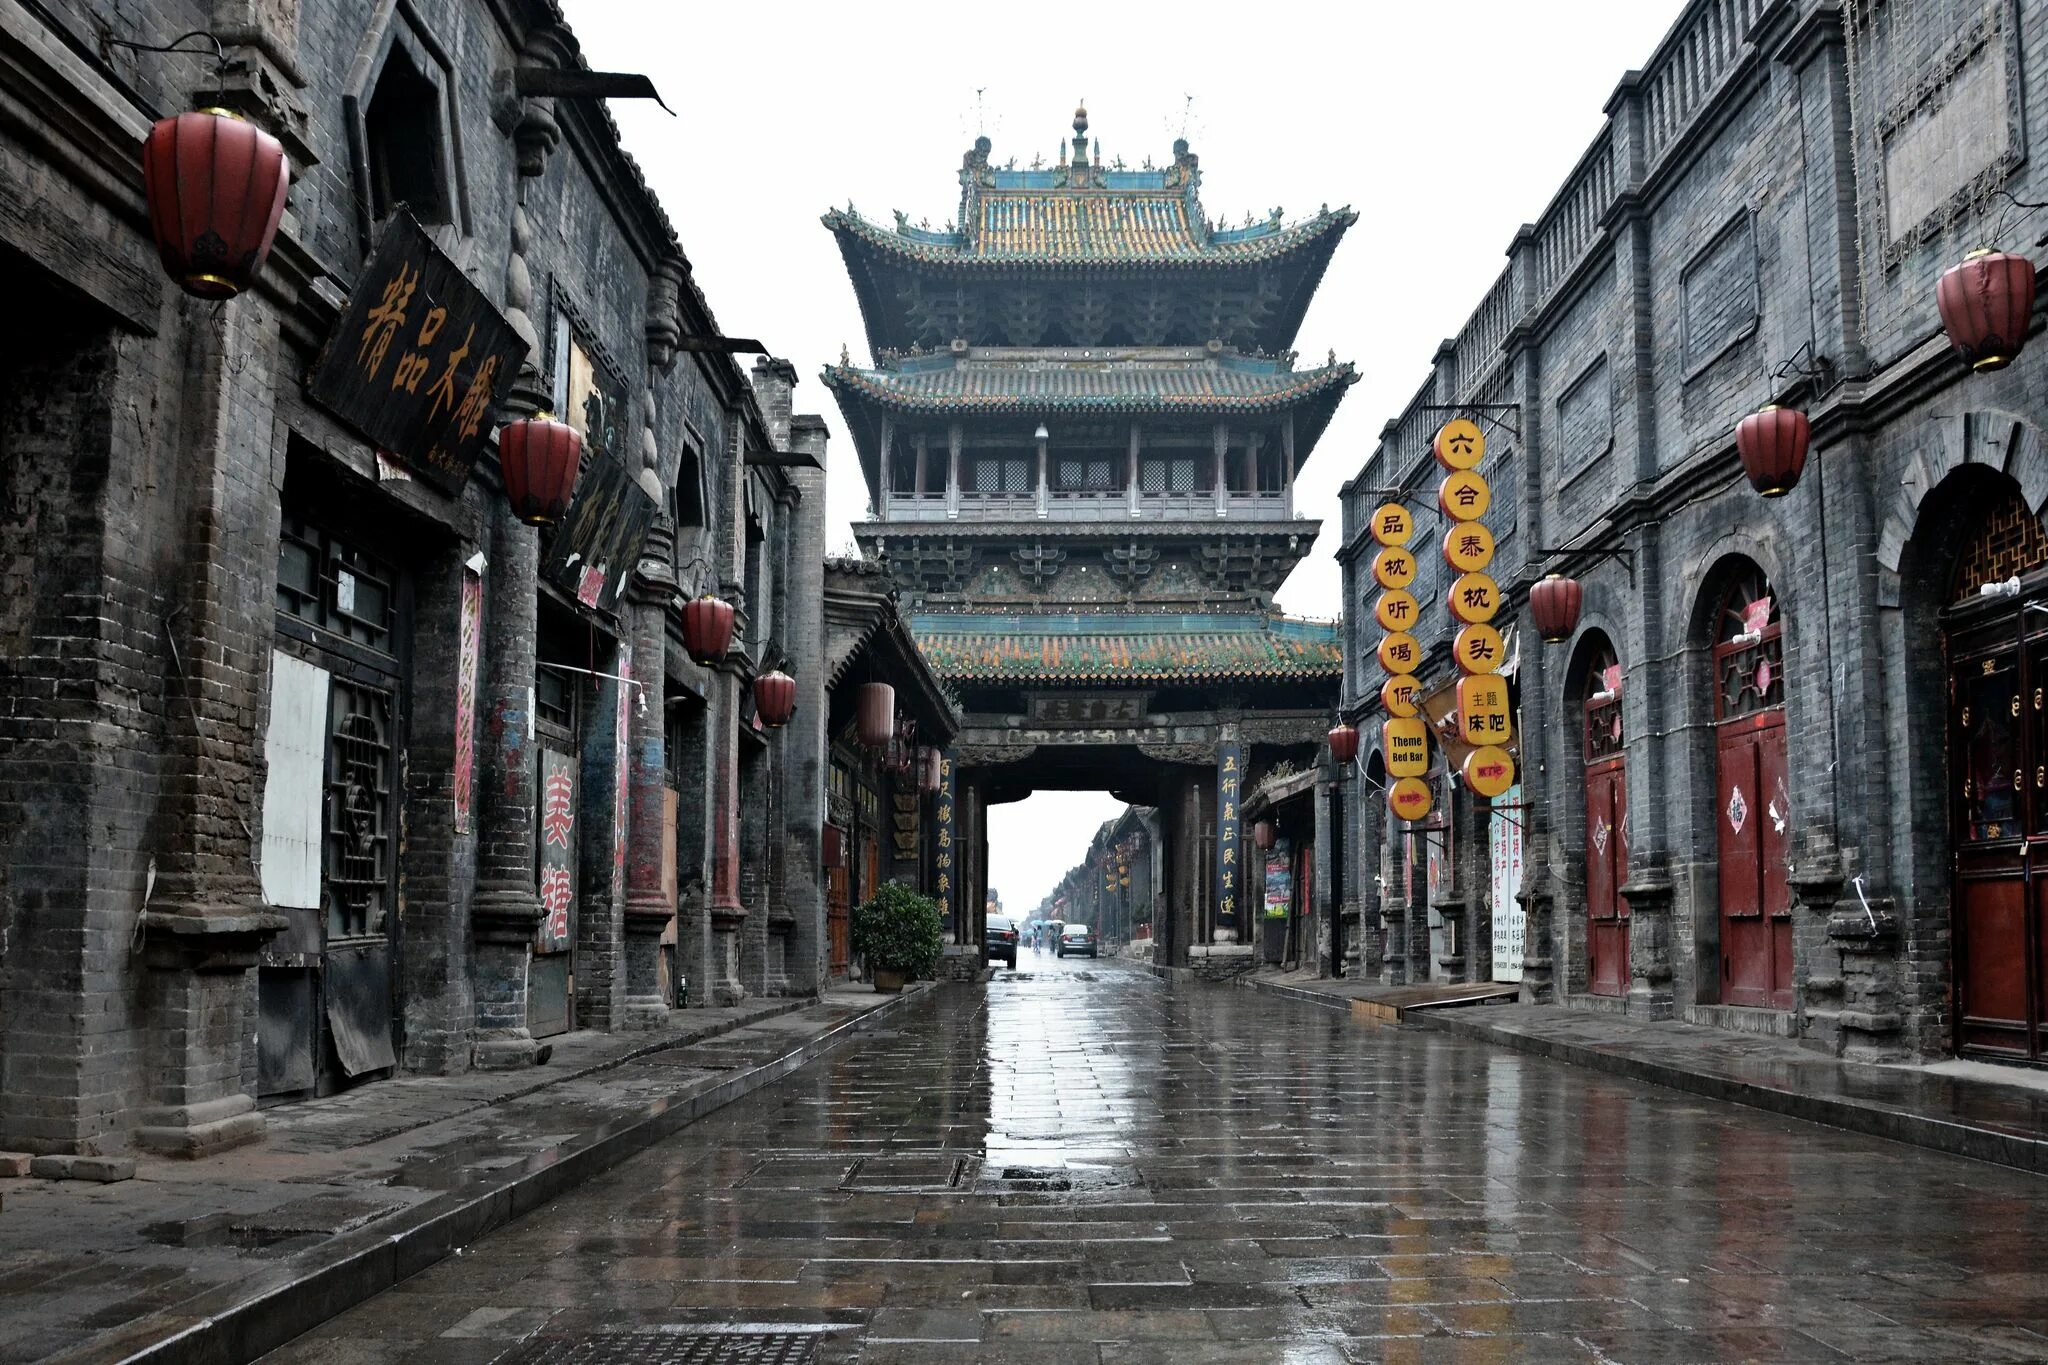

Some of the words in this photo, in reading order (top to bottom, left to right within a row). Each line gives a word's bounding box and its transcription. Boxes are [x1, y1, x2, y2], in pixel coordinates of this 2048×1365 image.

[1450, 434, 1494, 661] 六合泰枕头
[1382, 515, 1413, 706] 品枕听喝侃
[1473, 692, 1498, 707] 主题
[1469, 714, 1505, 732] 床吧
[1393, 737, 1422, 747] Theme
[1393, 753, 1407, 761] Bed
[1410, 752, 1423, 761] Bar
[541, 764, 574, 939] 姜糖
